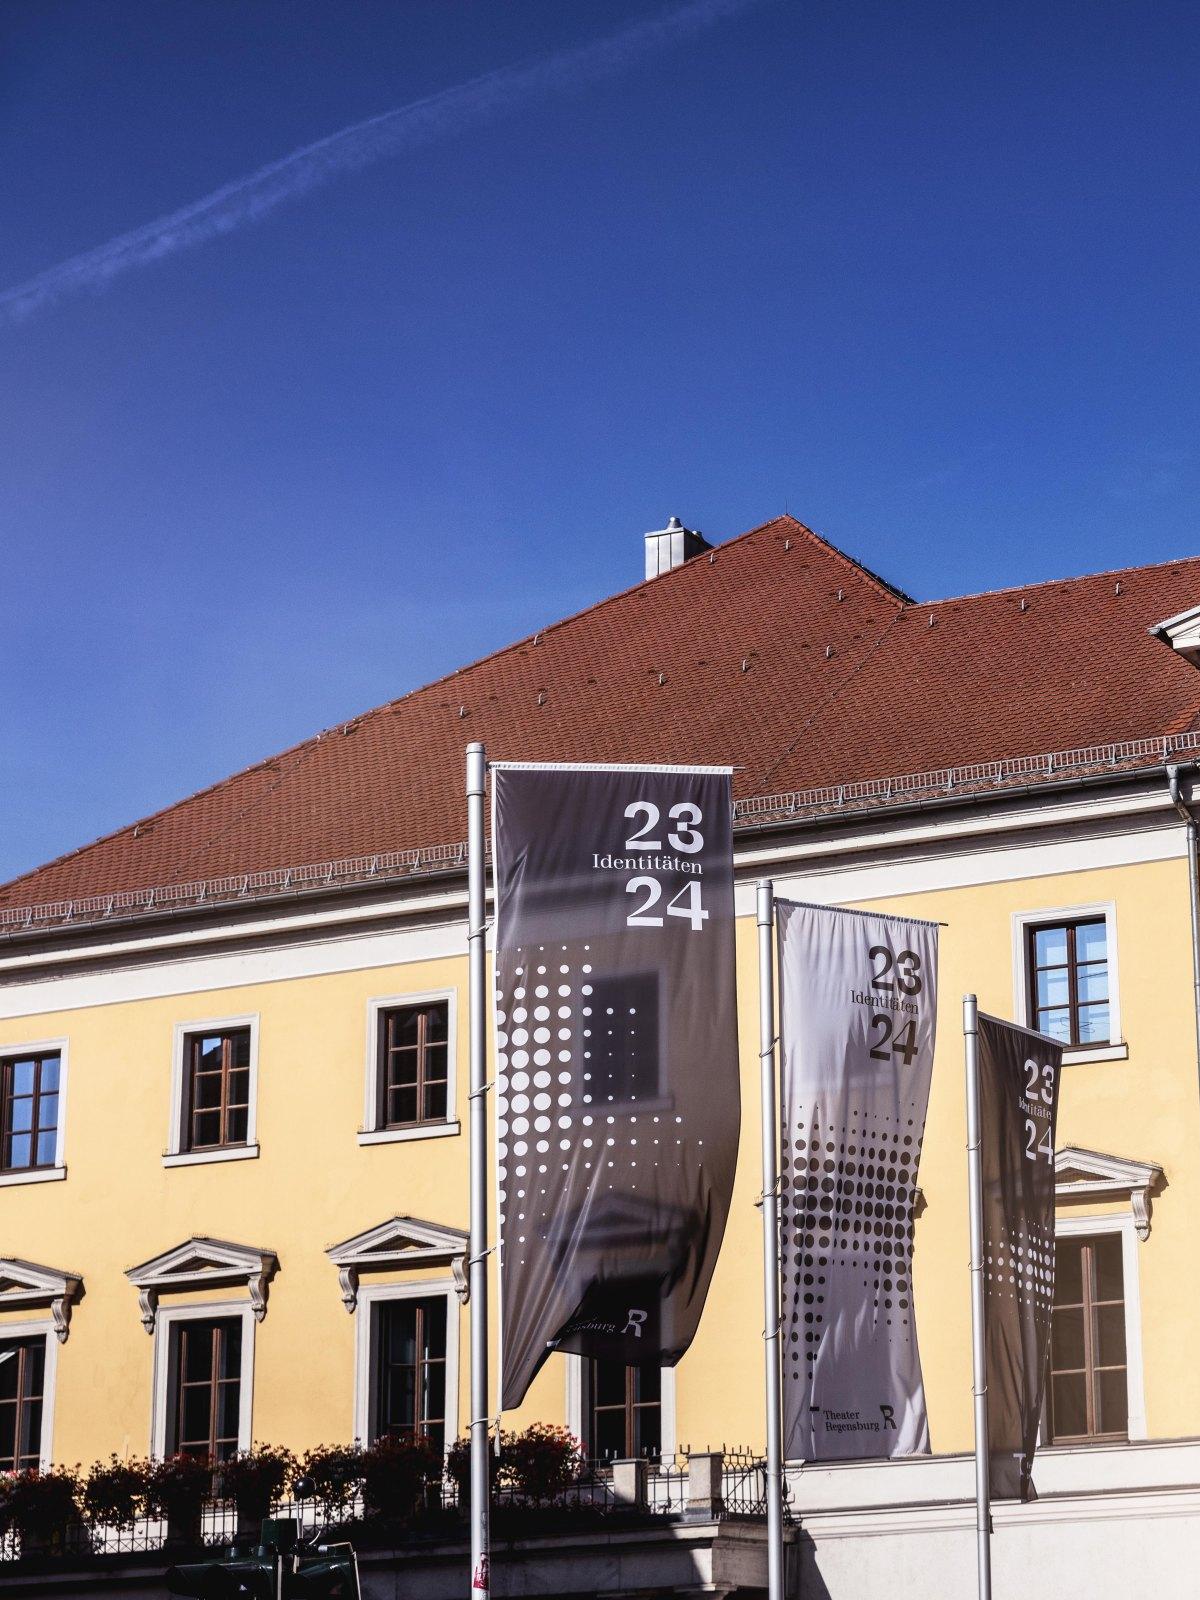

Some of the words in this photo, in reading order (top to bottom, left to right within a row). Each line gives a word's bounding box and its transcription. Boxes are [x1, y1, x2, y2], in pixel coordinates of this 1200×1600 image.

[624, 801, 704, 853] 23
[592, 853, 703, 875] Identitäten
[625, 876, 709, 931] 24
[868, 945, 922, 996] 23
[850, 990, 919, 1014] Identitäten
[869, 1013, 919, 1065] 24
[1024, 1059, 1054, 1105] 23
[1025, 1119, 1053, 1165] 24
[620, 1309, 648, 1337] R
[822, 1410, 861, 1420] Theater
[825, 1421, 880, 1434] Regensburg
[879, 1404, 898, 1430] R
